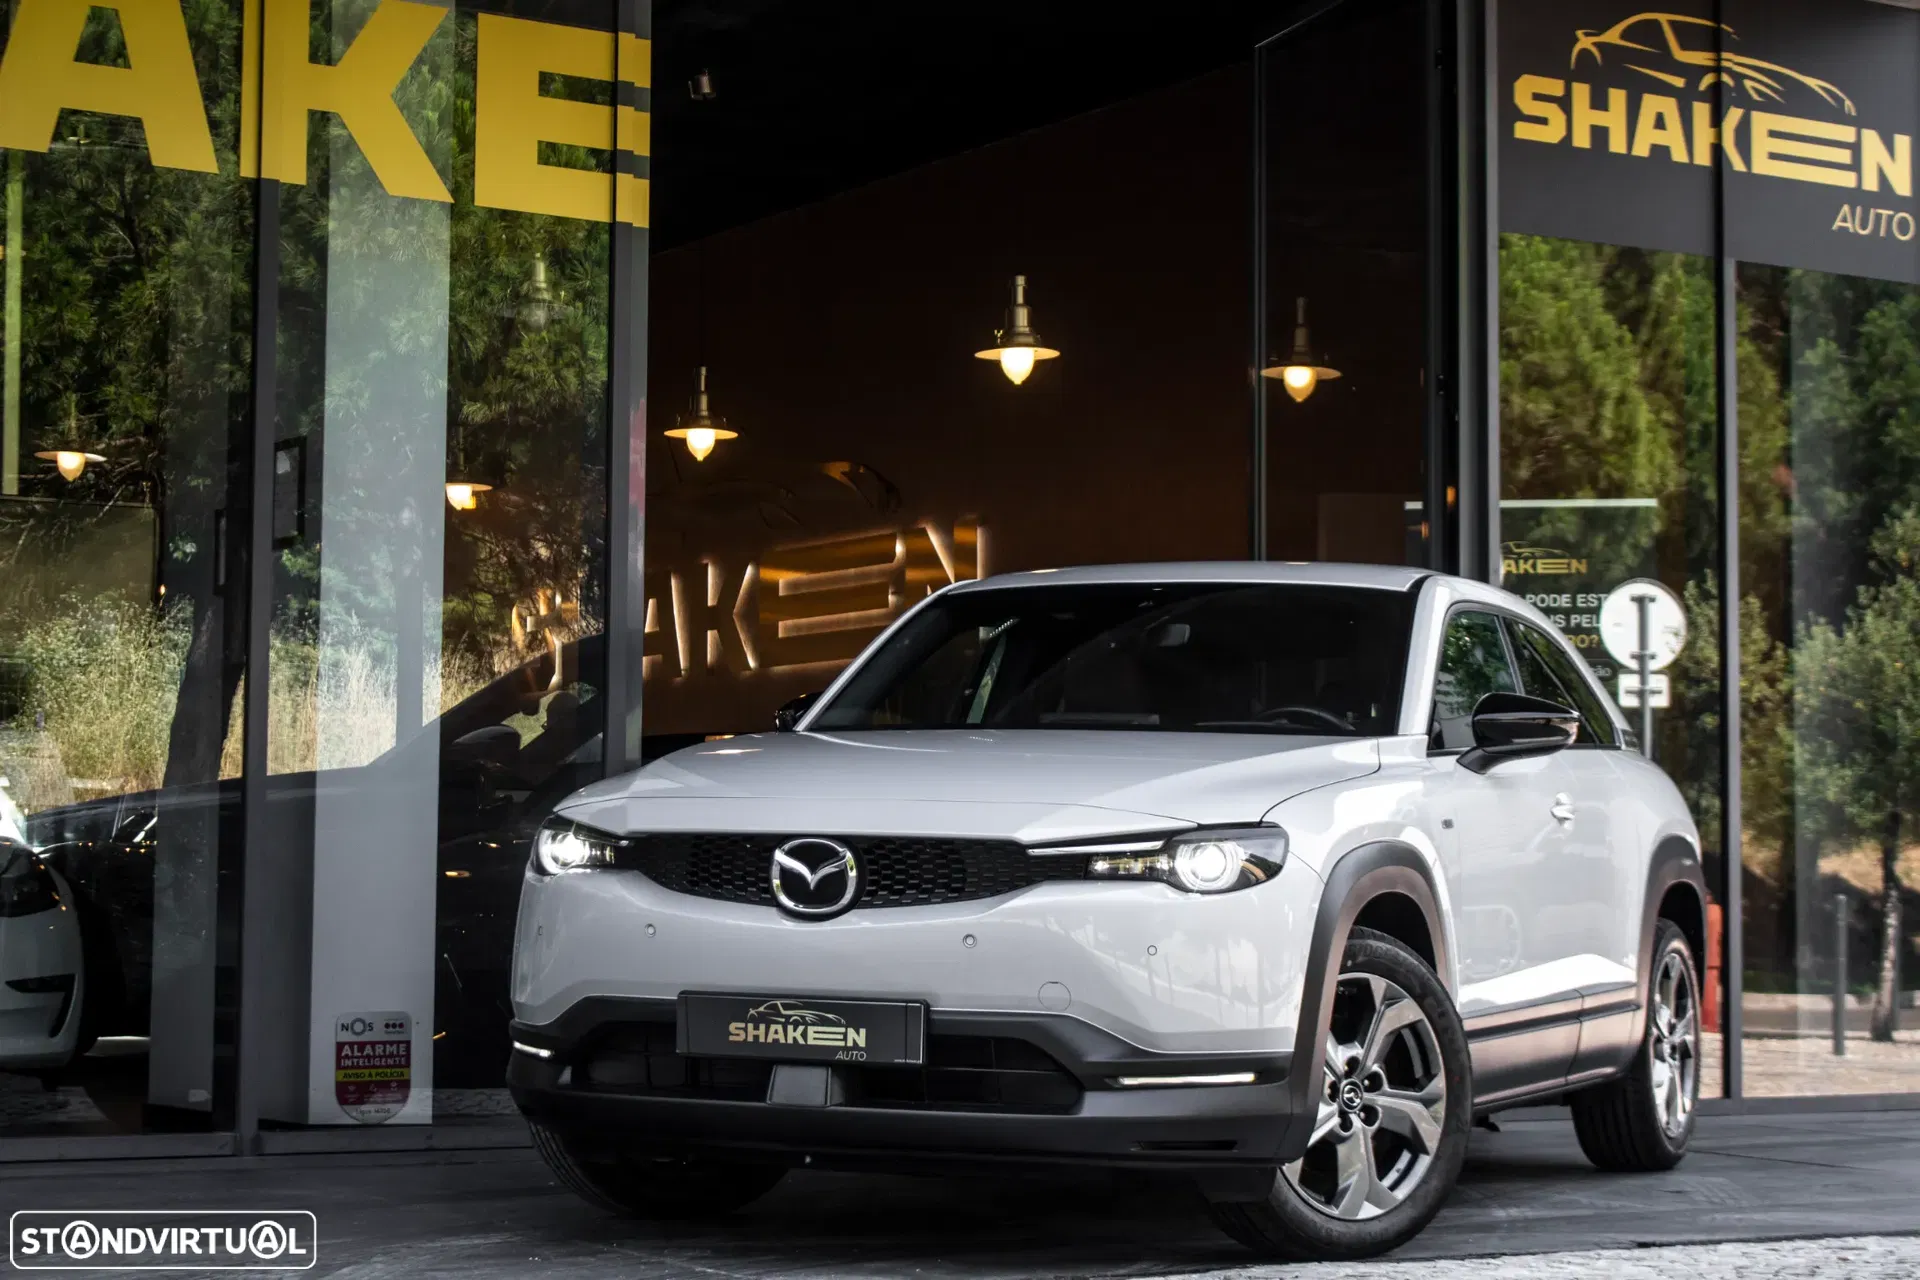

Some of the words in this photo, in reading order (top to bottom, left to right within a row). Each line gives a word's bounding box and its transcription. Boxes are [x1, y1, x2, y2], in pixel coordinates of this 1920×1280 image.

[1513, 74, 1912, 197] SHAKEN
[1832, 204, 1916, 241] AUTO
[1525, 593, 1572, 608] PODE
[341, 1017, 375, 1036] NOS
[728, 1022, 866, 1048] SHAKEN
[341, 1044, 408, 1057] ALARME
[835, 1050, 867, 1061] AUTO
[340, 1057, 407, 1067] INTELIGENTE
